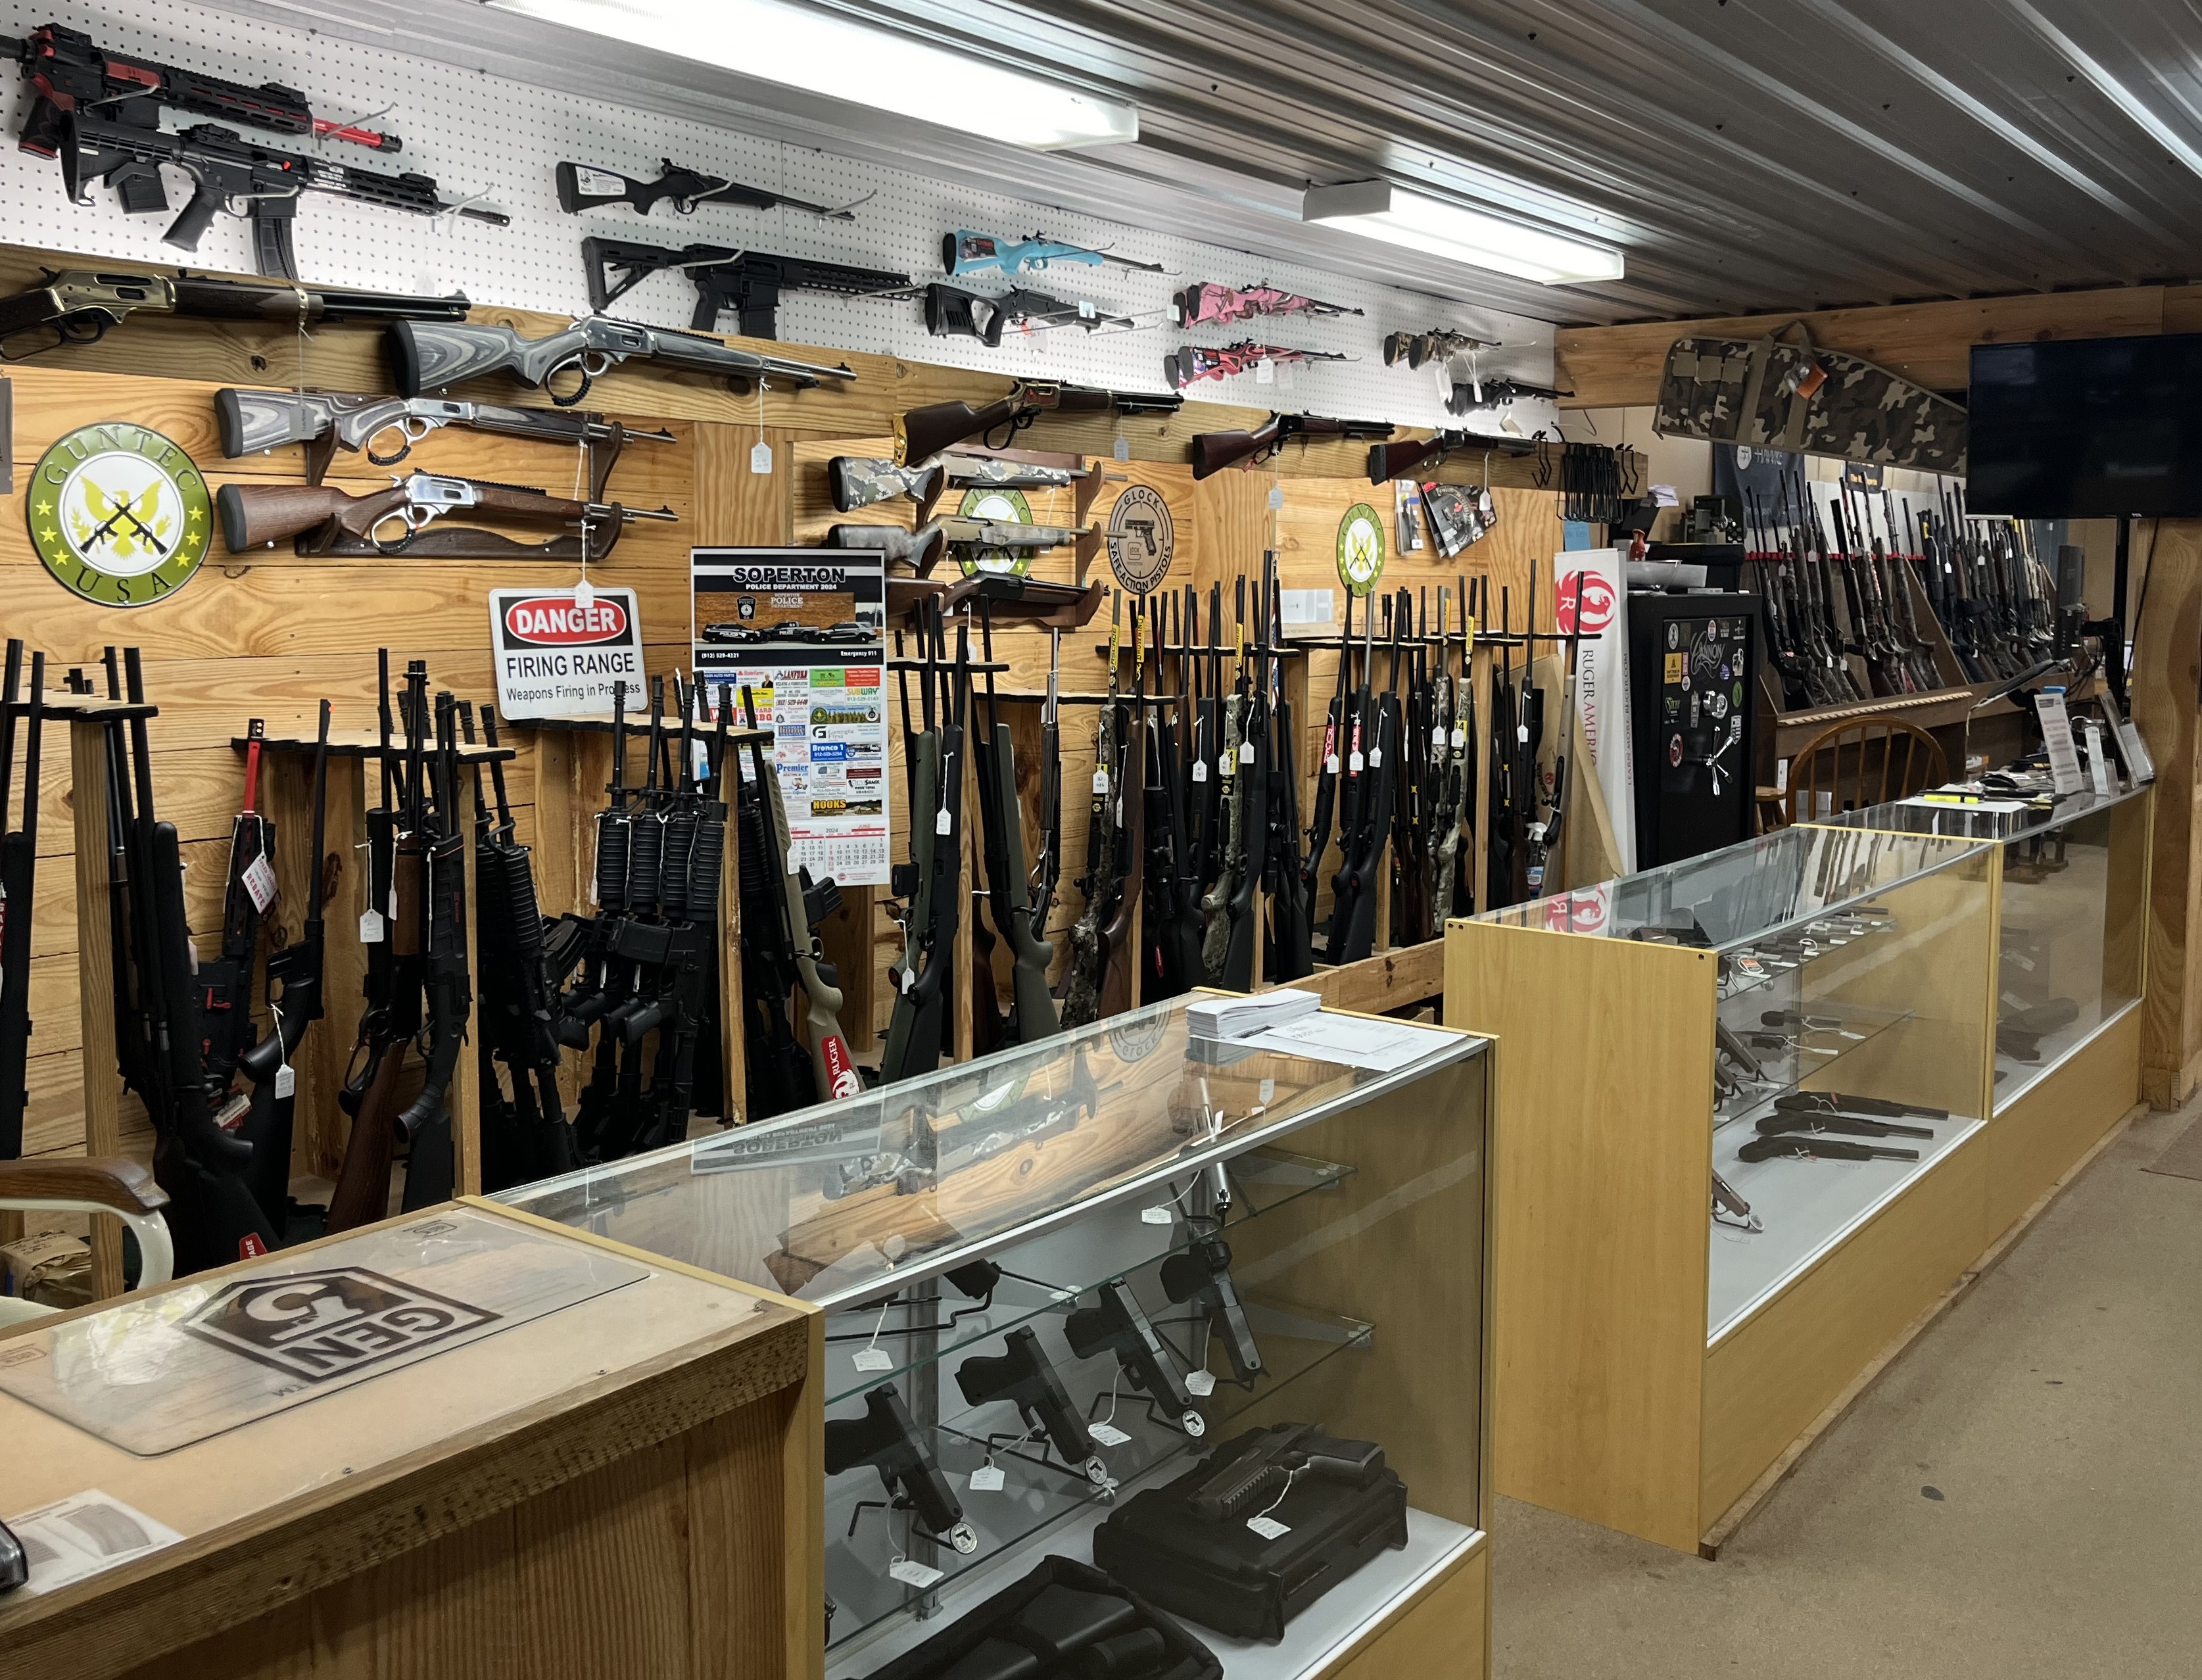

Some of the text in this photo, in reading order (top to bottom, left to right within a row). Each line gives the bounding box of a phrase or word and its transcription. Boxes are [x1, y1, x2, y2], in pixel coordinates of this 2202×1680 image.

[45, 426, 197, 491] GUNTEC
[1124, 490, 1159, 509] GLOCK
[733, 567, 846, 583] SOPERTON
[1150, 546, 1170, 586] PISTOLS
[76, 564, 172, 603] USA
[515, 608, 617, 634] DANGER
[506, 653, 634, 679] FIRING RANGE
[506, 683, 640, 703] Weapons Firing in Proess
[1583, 650, 1597, 767] RUGER AMERIC
[776, 764, 808, 773] Premier
[813, 800, 846, 809] HOOKS
[828, 1038, 840, 1075] RUGER
[279, 1307, 456, 1370] GEN
